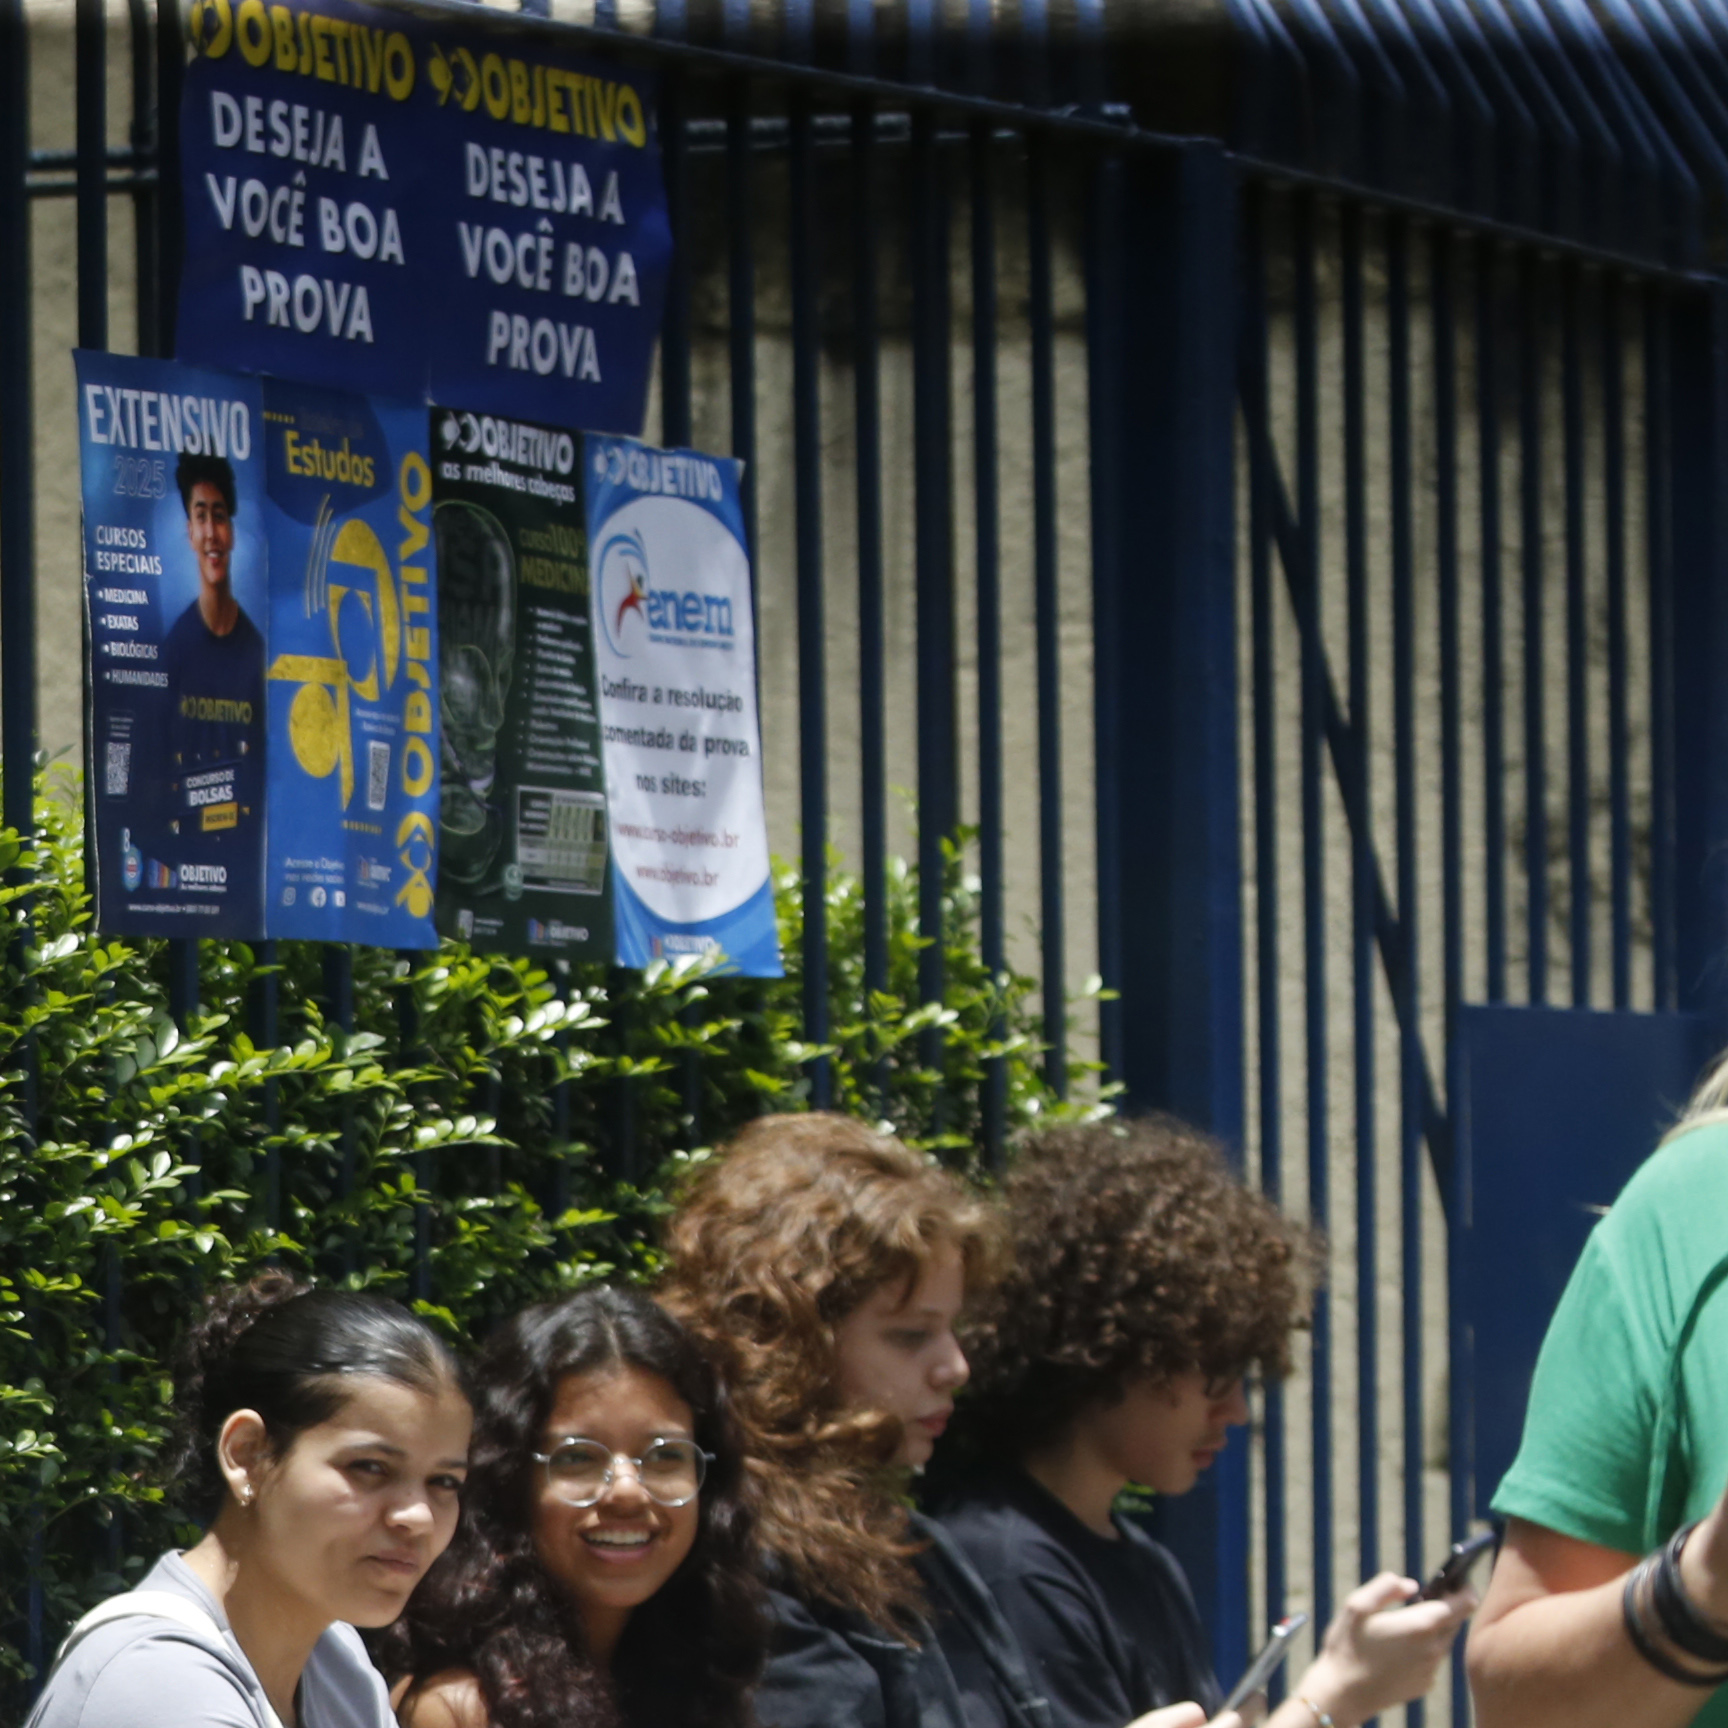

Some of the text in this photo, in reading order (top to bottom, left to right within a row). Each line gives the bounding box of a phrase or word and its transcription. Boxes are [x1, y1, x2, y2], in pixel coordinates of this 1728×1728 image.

[236, 0, 416, 101] OBJETIVO
[481, 53, 647, 148] OBJETIVO
[210, 90, 390, 181] DESEJA A
[465, 141, 625, 226] DESEJA A
[205, 170, 406, 266] VOCÊ BOA
[457, 217, 640, 307] VOCÊ BOA
[239, 264, 375, 344] PROVA
[486, 309, 603, 384] PROVA
[84, 383, 252, 461] EXTENSIVO
[284, 430, 376, 488] Estudos
[482, 416, 575, 475] OBJETIVO
[112, 455, 167, 499] 2025
[441, 461, 576, 506] as melhores cabeças
[627, 448, 724, 501] OBJETIVO
[96, 525, 147, 549] CURSOS
[96, 550, 163, 576] ESPECIAIS
[104, 588, 150, 606] MEDICINA
[647, 587, 736, 637] enem
[107, 615, 140, 632] EXATAS
[398, 451, 435, 798] OBJETIVO
[110, 640, 159, 660] BIOLÓGICAS
[111, 670, 169, 689] HUMANIDADES
[601, 674, 744, 715] Confira a resolução
[197, 698, 253, 725] OBJETIVO
[602, 723, 751, 759] comentada da prova
[186, 770, 222, 789] CONCURSO
[188, 785, 234, 807] BOLSAS
[636, 773, 707, 798] nos sites:
[616, 821, 741, 849] www.curso-objetivo.br
[180, 863, 228, 885] OBJETIVO
[636, 862, 720, 888] www.objetivo.br
